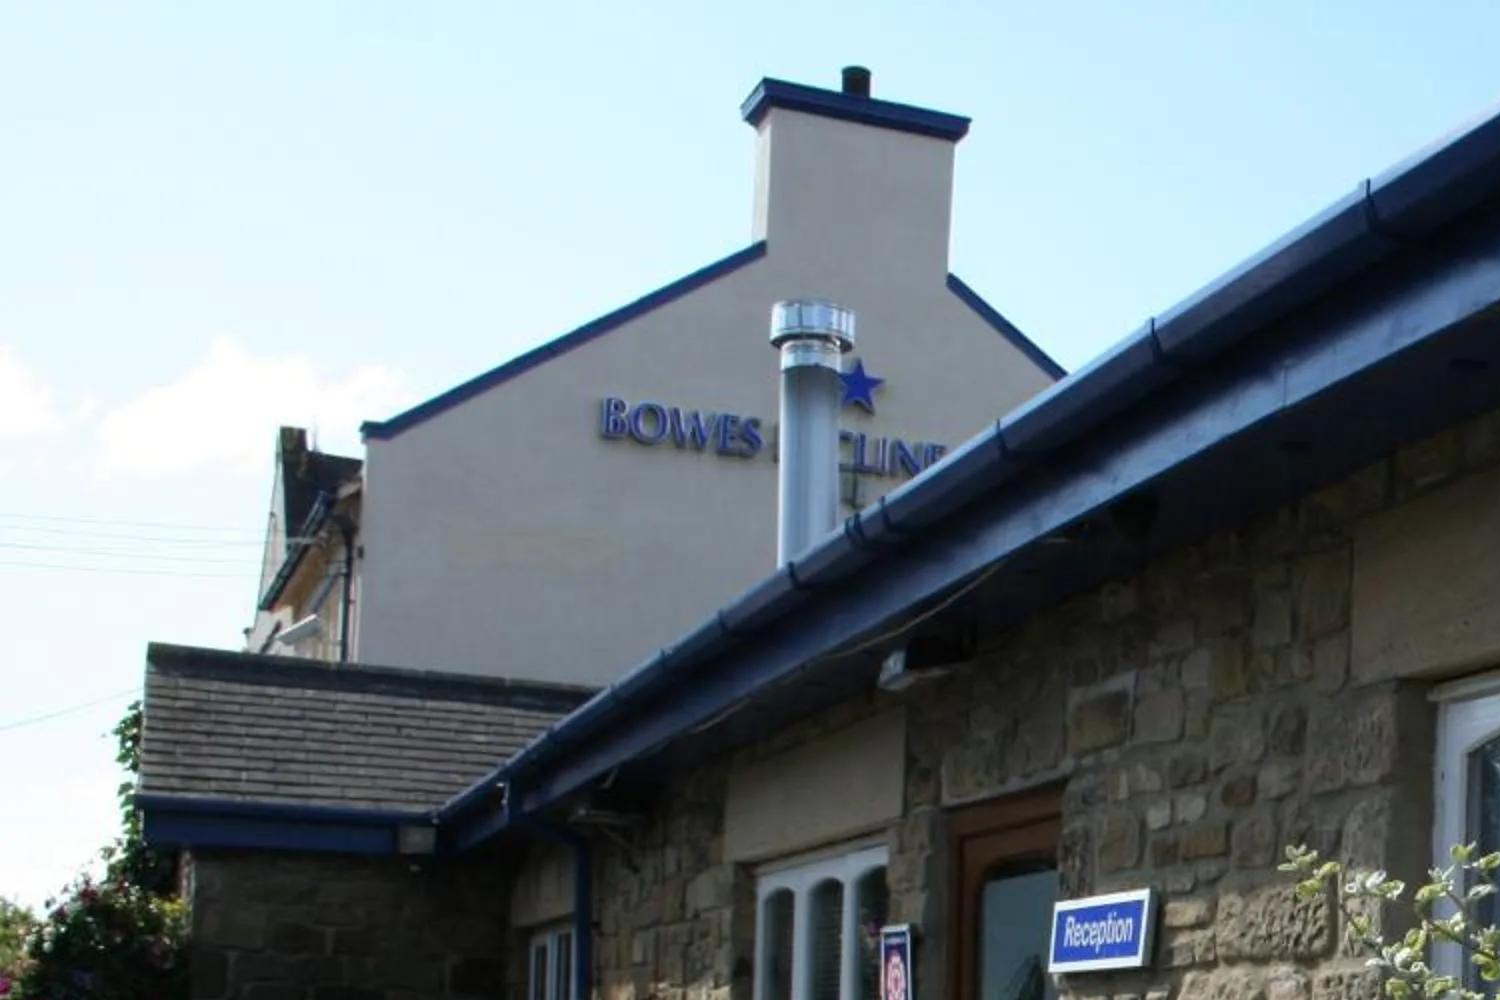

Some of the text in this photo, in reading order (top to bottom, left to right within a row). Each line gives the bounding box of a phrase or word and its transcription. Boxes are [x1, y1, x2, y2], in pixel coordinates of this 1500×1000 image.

[601, 397, 948, 478] BOWES LINE
[1063, 911, 1134, 954] Reception
